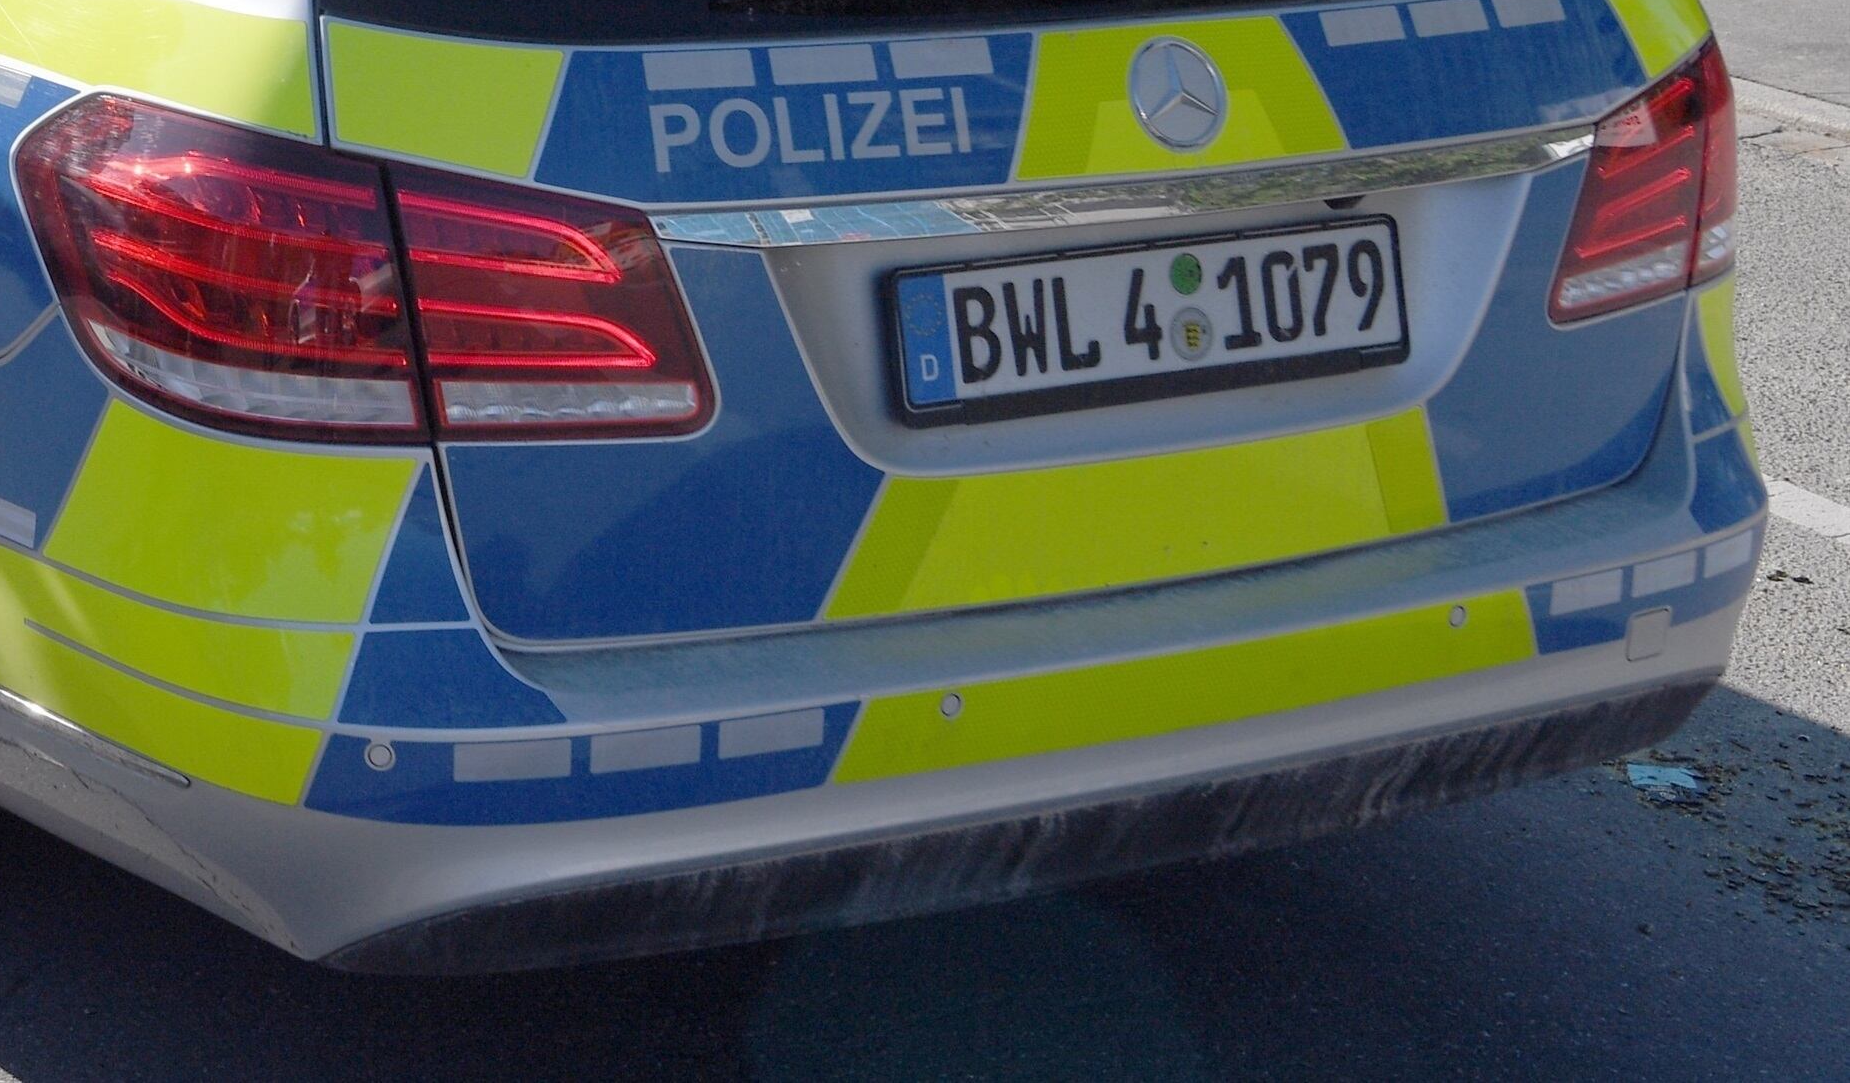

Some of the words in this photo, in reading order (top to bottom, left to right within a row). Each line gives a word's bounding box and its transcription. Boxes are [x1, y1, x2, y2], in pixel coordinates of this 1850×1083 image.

[649, 86, 971, 173] POLIZEI
[919, 353, 939, 382] D
[953, 277, 1100, 384] BWL
[1124, 268, 1162, 360] 4
[1217, 239, 1385, 351] 1079
